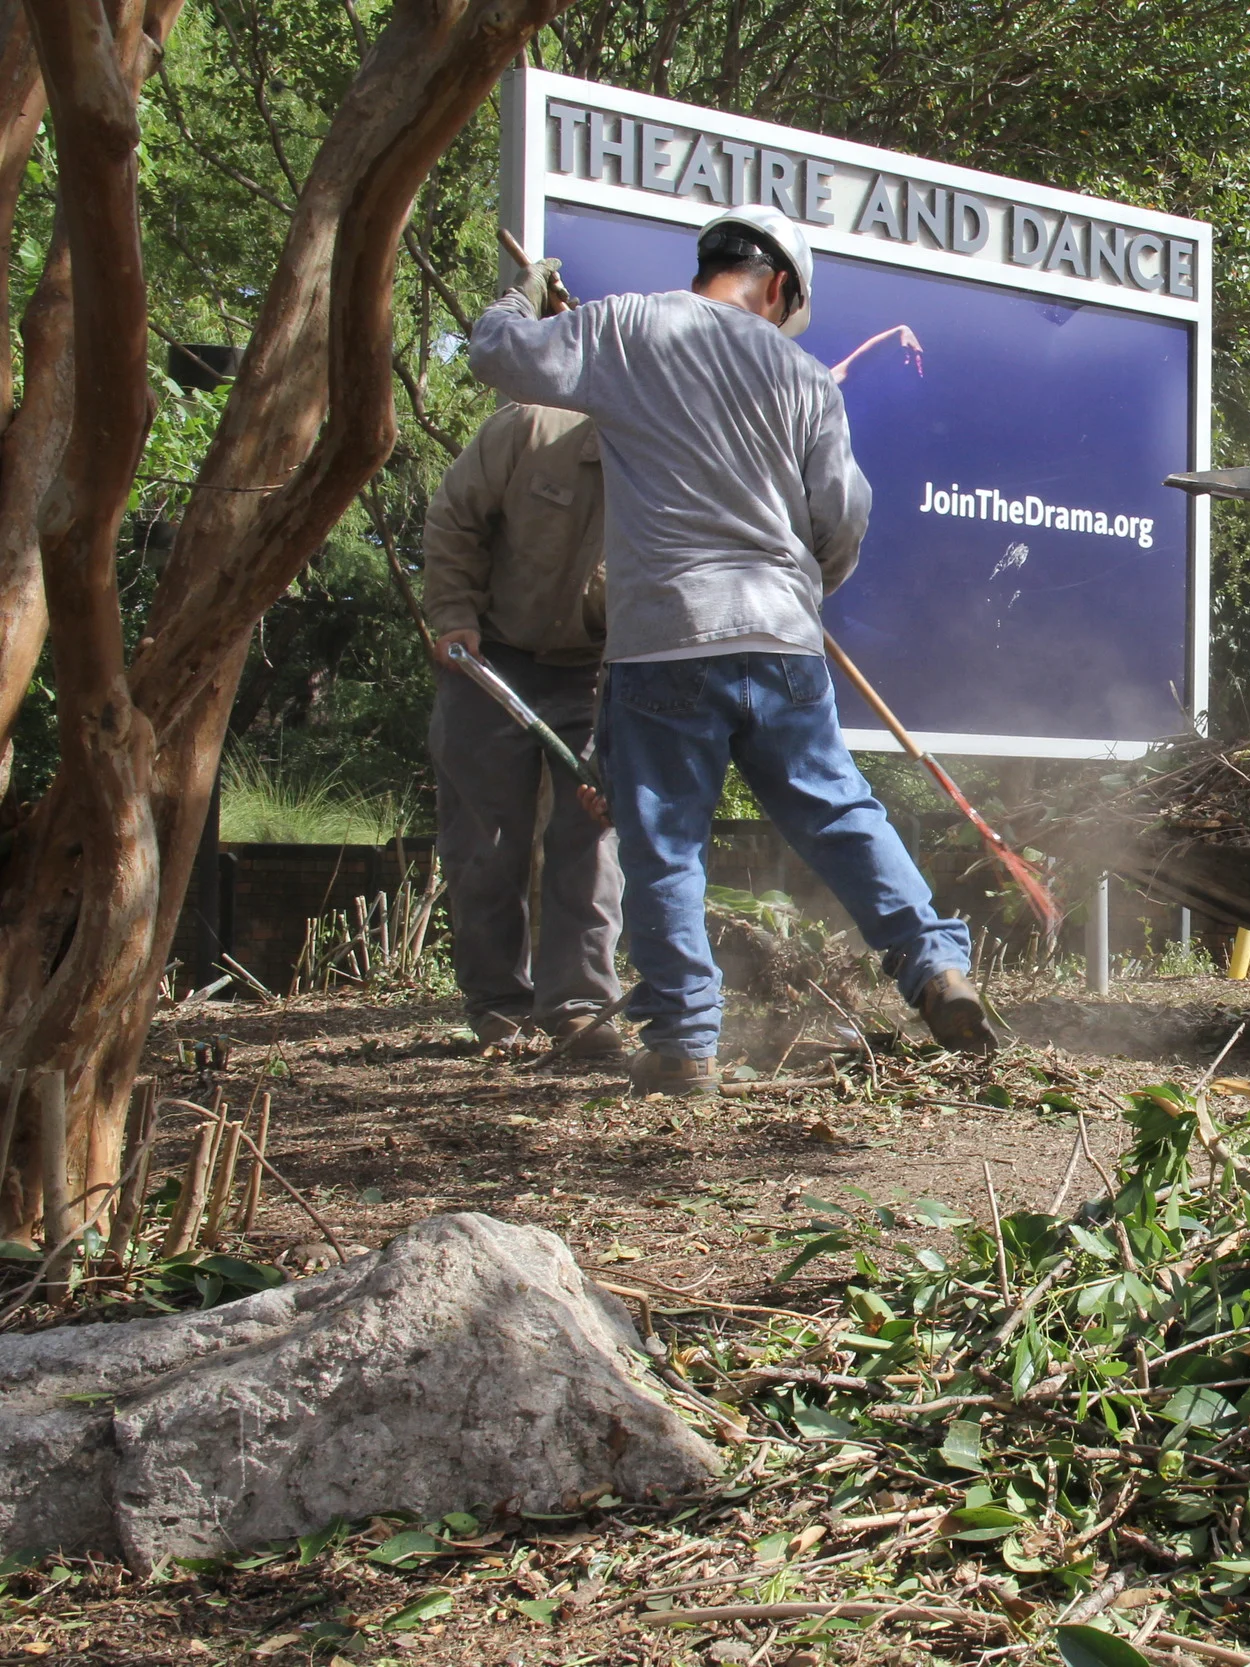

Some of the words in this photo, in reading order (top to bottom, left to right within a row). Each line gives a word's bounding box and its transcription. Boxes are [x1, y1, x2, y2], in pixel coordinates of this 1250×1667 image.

[549, 103, 835, 226] THEATRE
[858, 173, 988, 255] AND
[1012, 205, 1194, 298] DANCE
[920, 482, 1154, 548] JoinTheDrama.org
